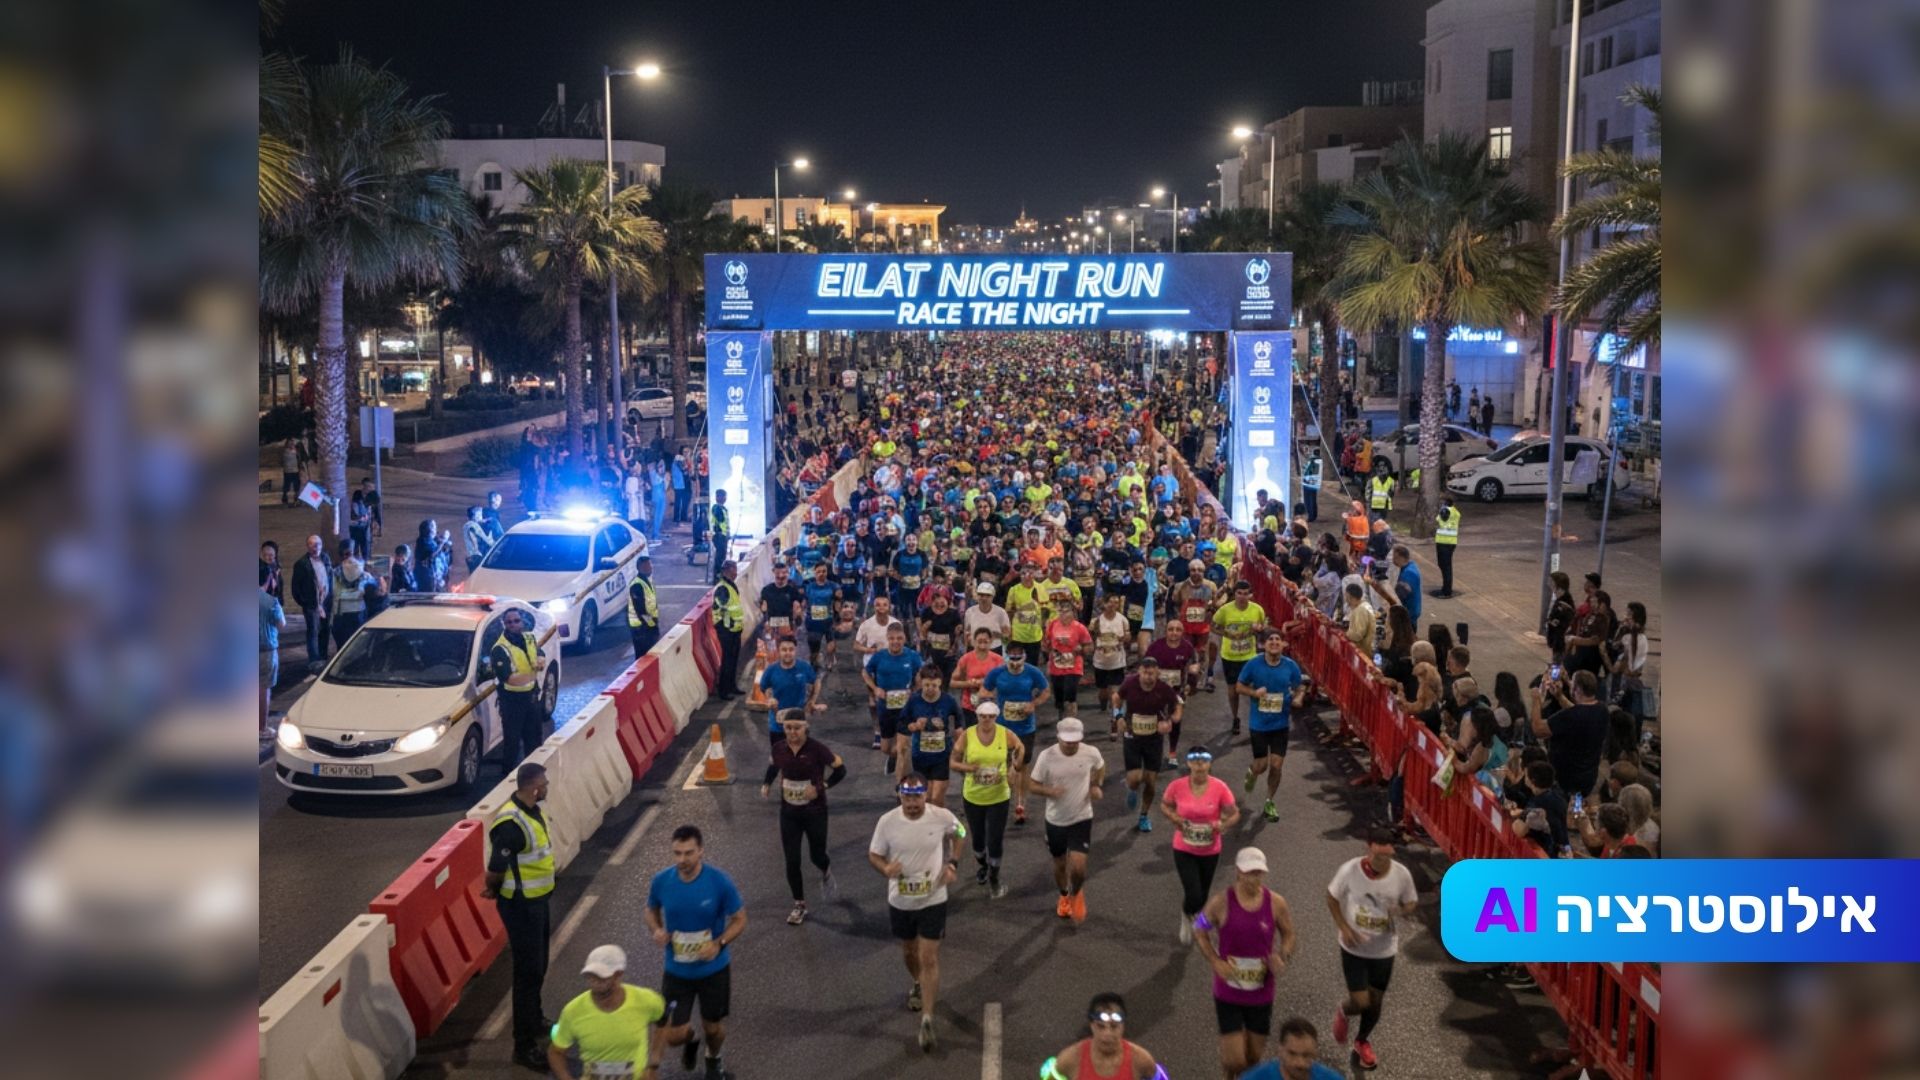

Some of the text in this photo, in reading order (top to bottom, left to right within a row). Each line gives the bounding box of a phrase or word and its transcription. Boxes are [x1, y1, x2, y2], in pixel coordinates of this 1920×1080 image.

[816, 261, 1165, 298] EILAT NIGHT RUN
[897, 302, 1104, 325] RACE THE NIGHT
